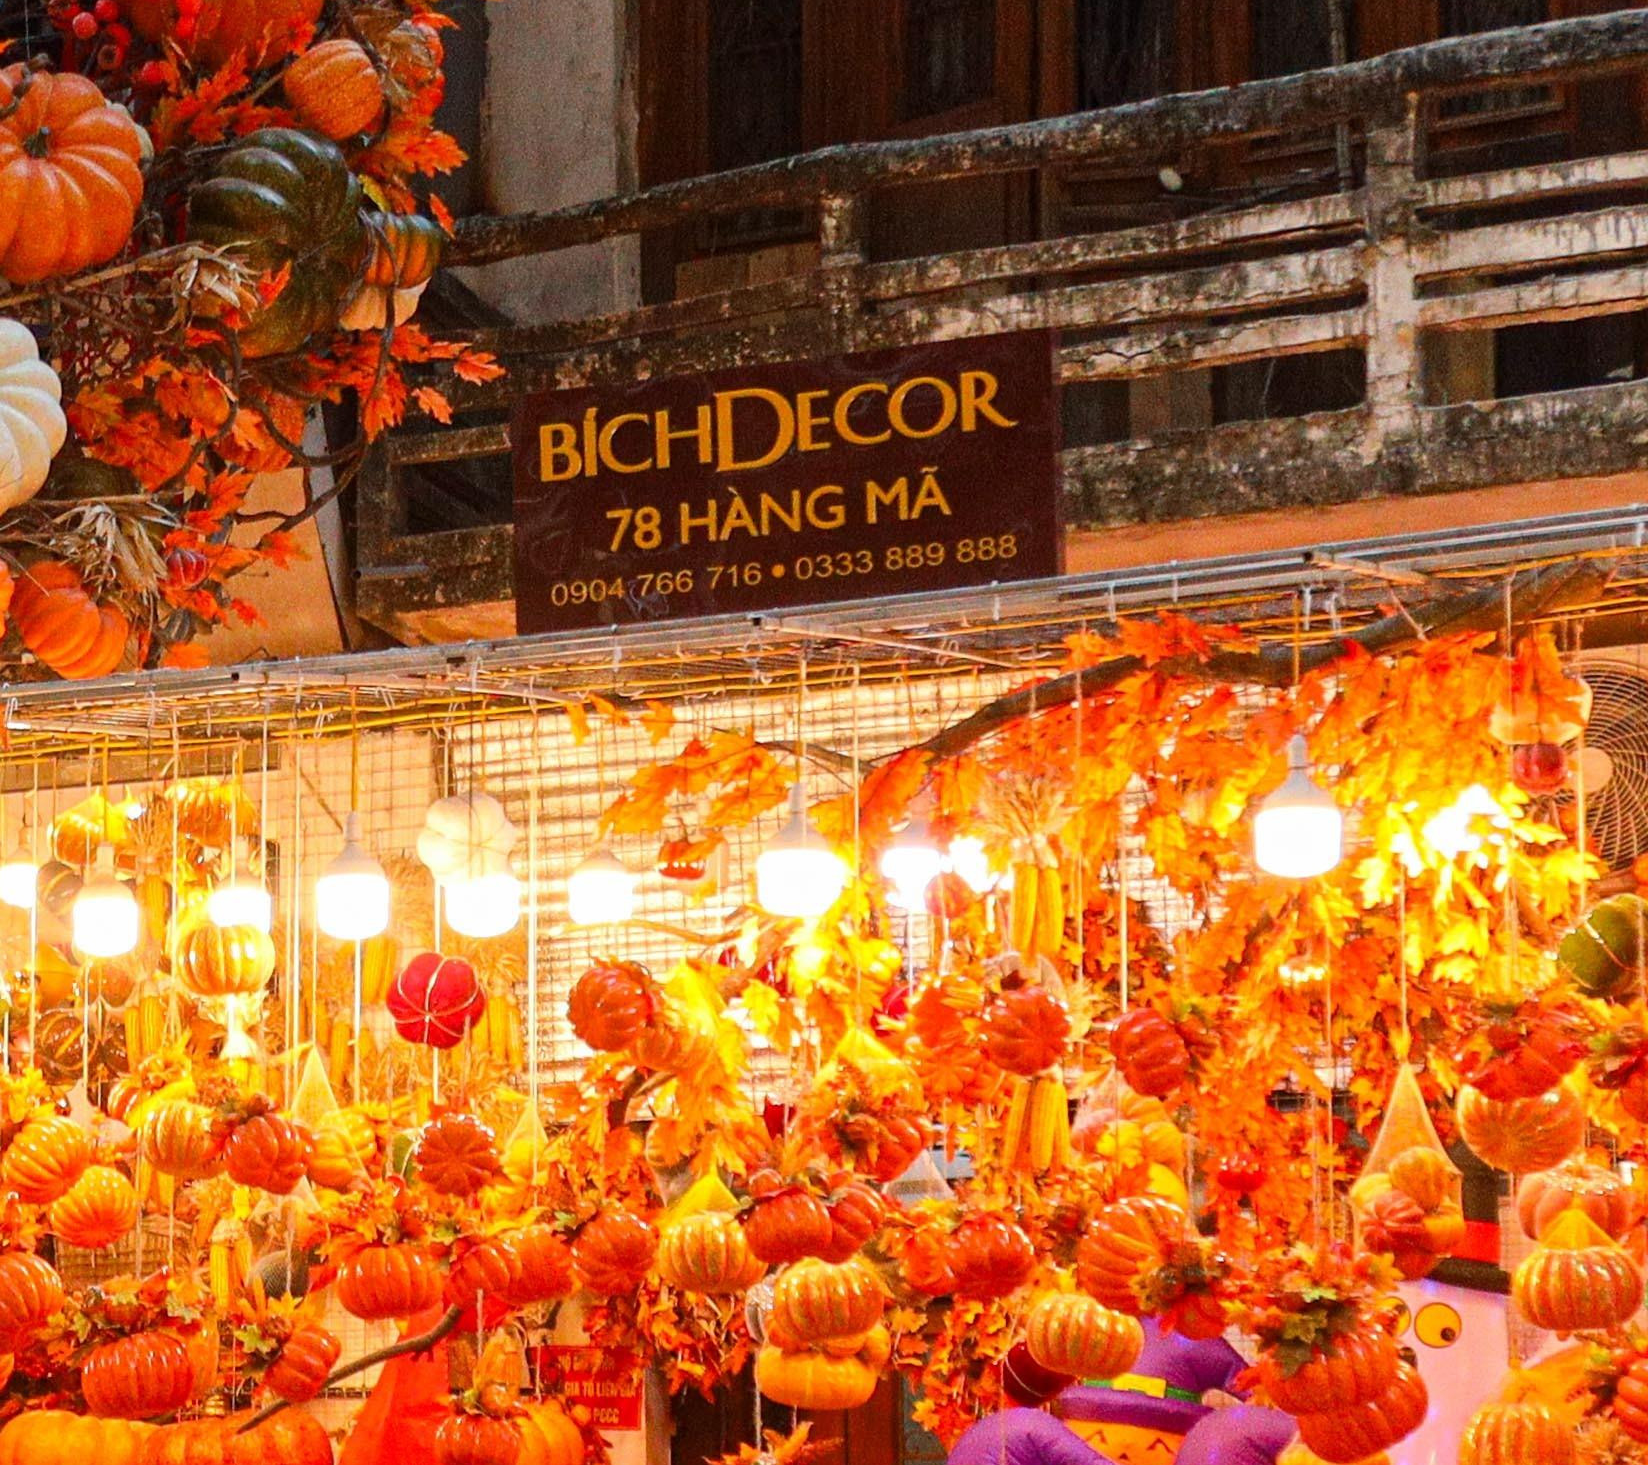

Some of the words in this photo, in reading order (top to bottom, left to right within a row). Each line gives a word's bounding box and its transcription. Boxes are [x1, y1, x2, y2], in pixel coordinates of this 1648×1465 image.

[606, 506, 661, 553] 78
[680, 484, 846, 545] HÀNG
[865, 466, 952, 524] MÃ
[550, 576, 624, 607] 0904
[636, 569, 693, 597] 766
[707, 561, 762, 590] 716
[795, 548, 874, 580] 0333
[886, 541, 945, 571] 889
[956, 533, 1018, 565] 888
